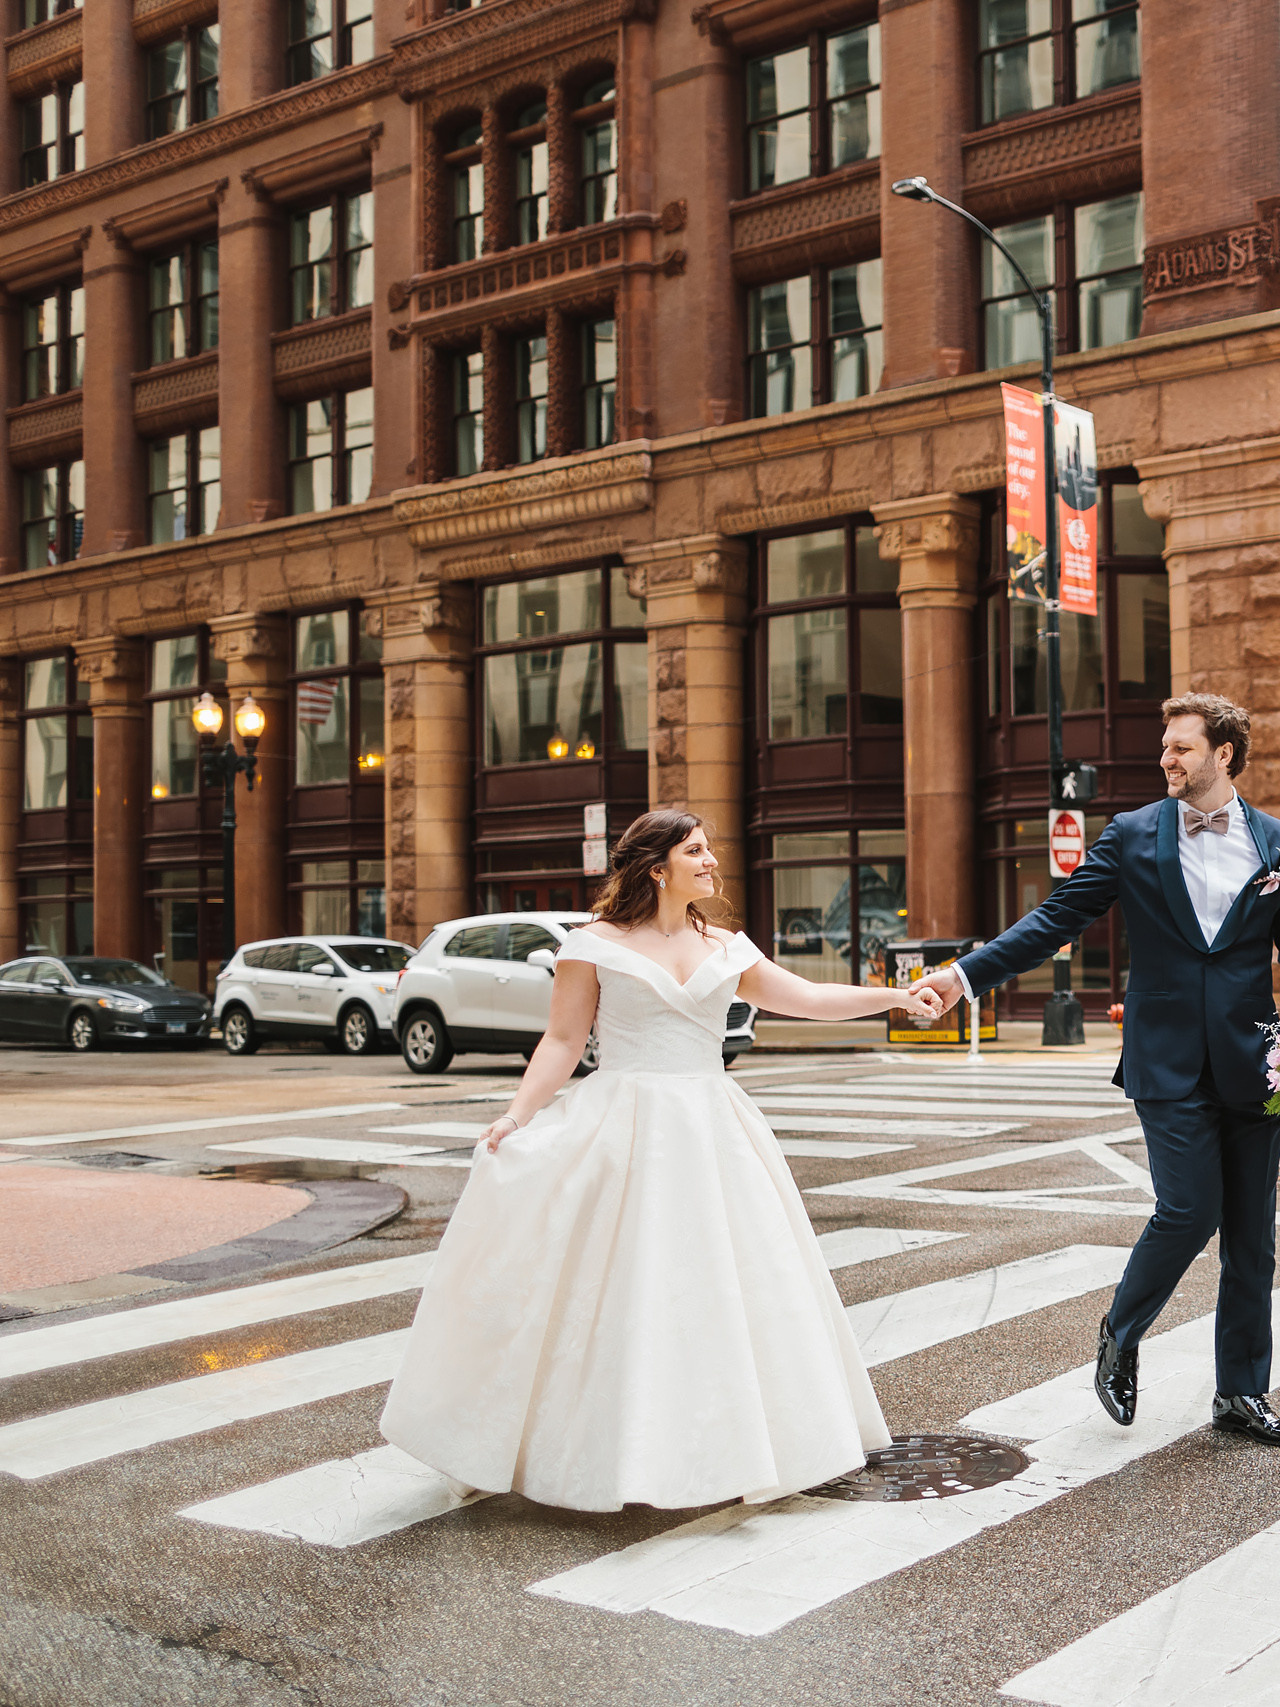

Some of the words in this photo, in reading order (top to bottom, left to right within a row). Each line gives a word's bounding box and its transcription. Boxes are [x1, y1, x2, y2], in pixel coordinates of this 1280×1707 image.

[1154, 242, 1228, 288] ADAMS
[1228, 230, 1256, 270] ST
[1006, 421, 1028, 441] The
[1007, 459, 1020, 476] of
[1020, 466, 1036, 480] our
[1055, 824, 1064, 836] DO
[1066, 824, 1078, 836] NOT
[1057, 852, 1077, 864] ENTER
